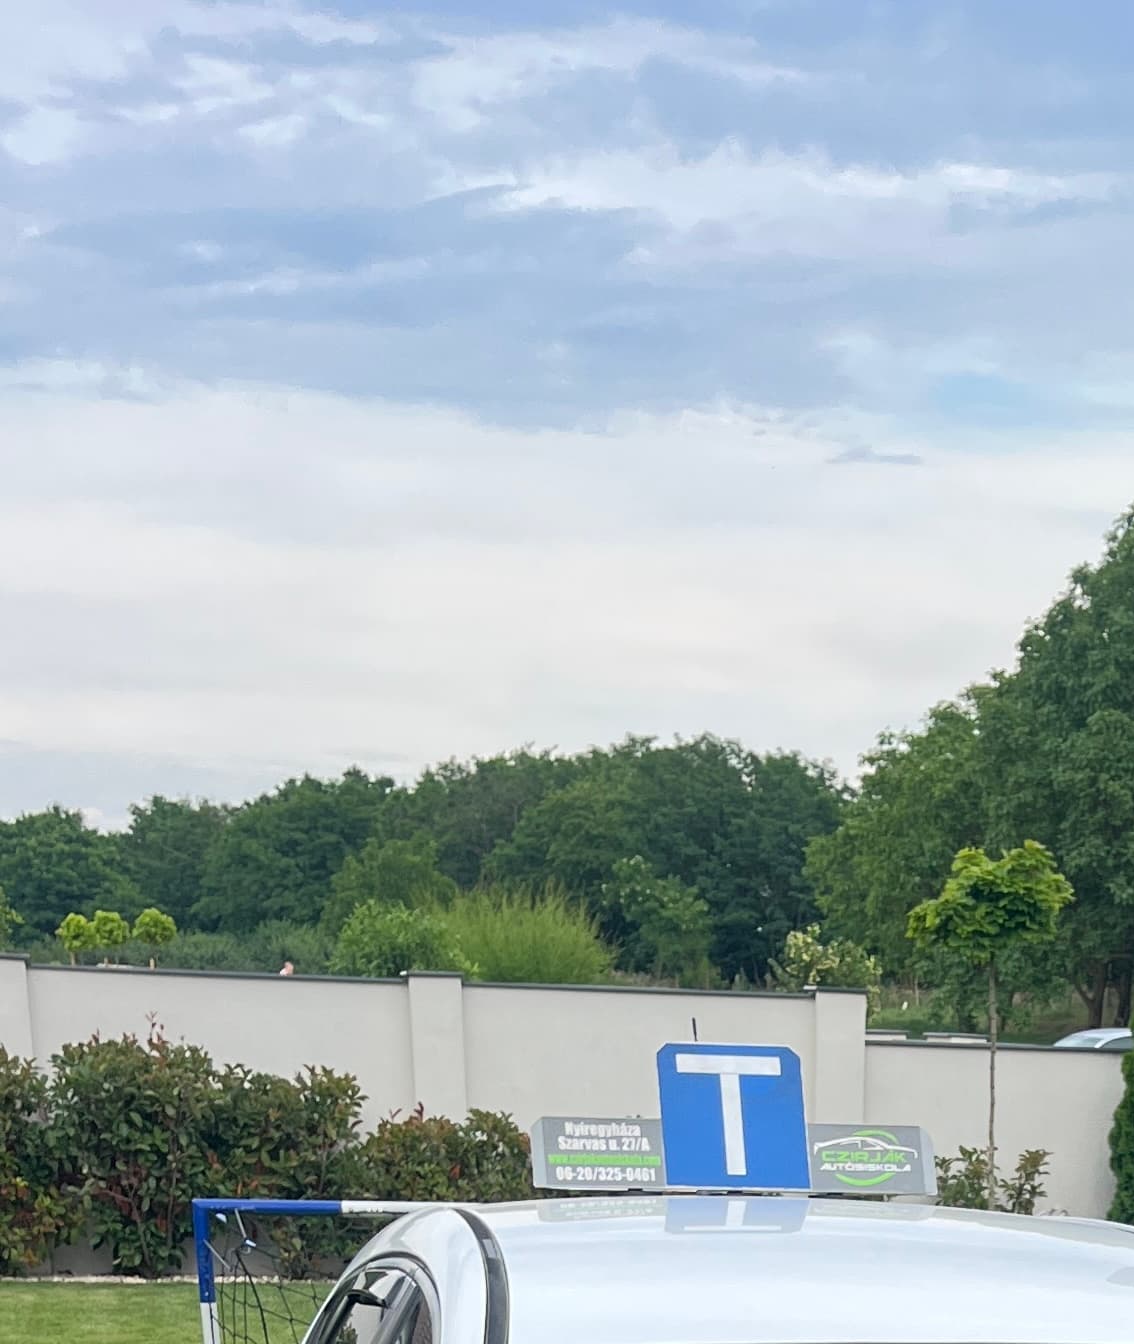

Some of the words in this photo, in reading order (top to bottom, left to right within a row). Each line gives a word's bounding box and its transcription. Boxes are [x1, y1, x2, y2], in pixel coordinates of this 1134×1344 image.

[675, 1053, 782, 1177] T
[557, 1135, 607, 1151] Szarvas
[622, 1137, 651, 1152] 27/A
[821, 1148, 907, 1162] CZIRJÁK
[555, 1166, 656, 1182] 06-20/325-0461
